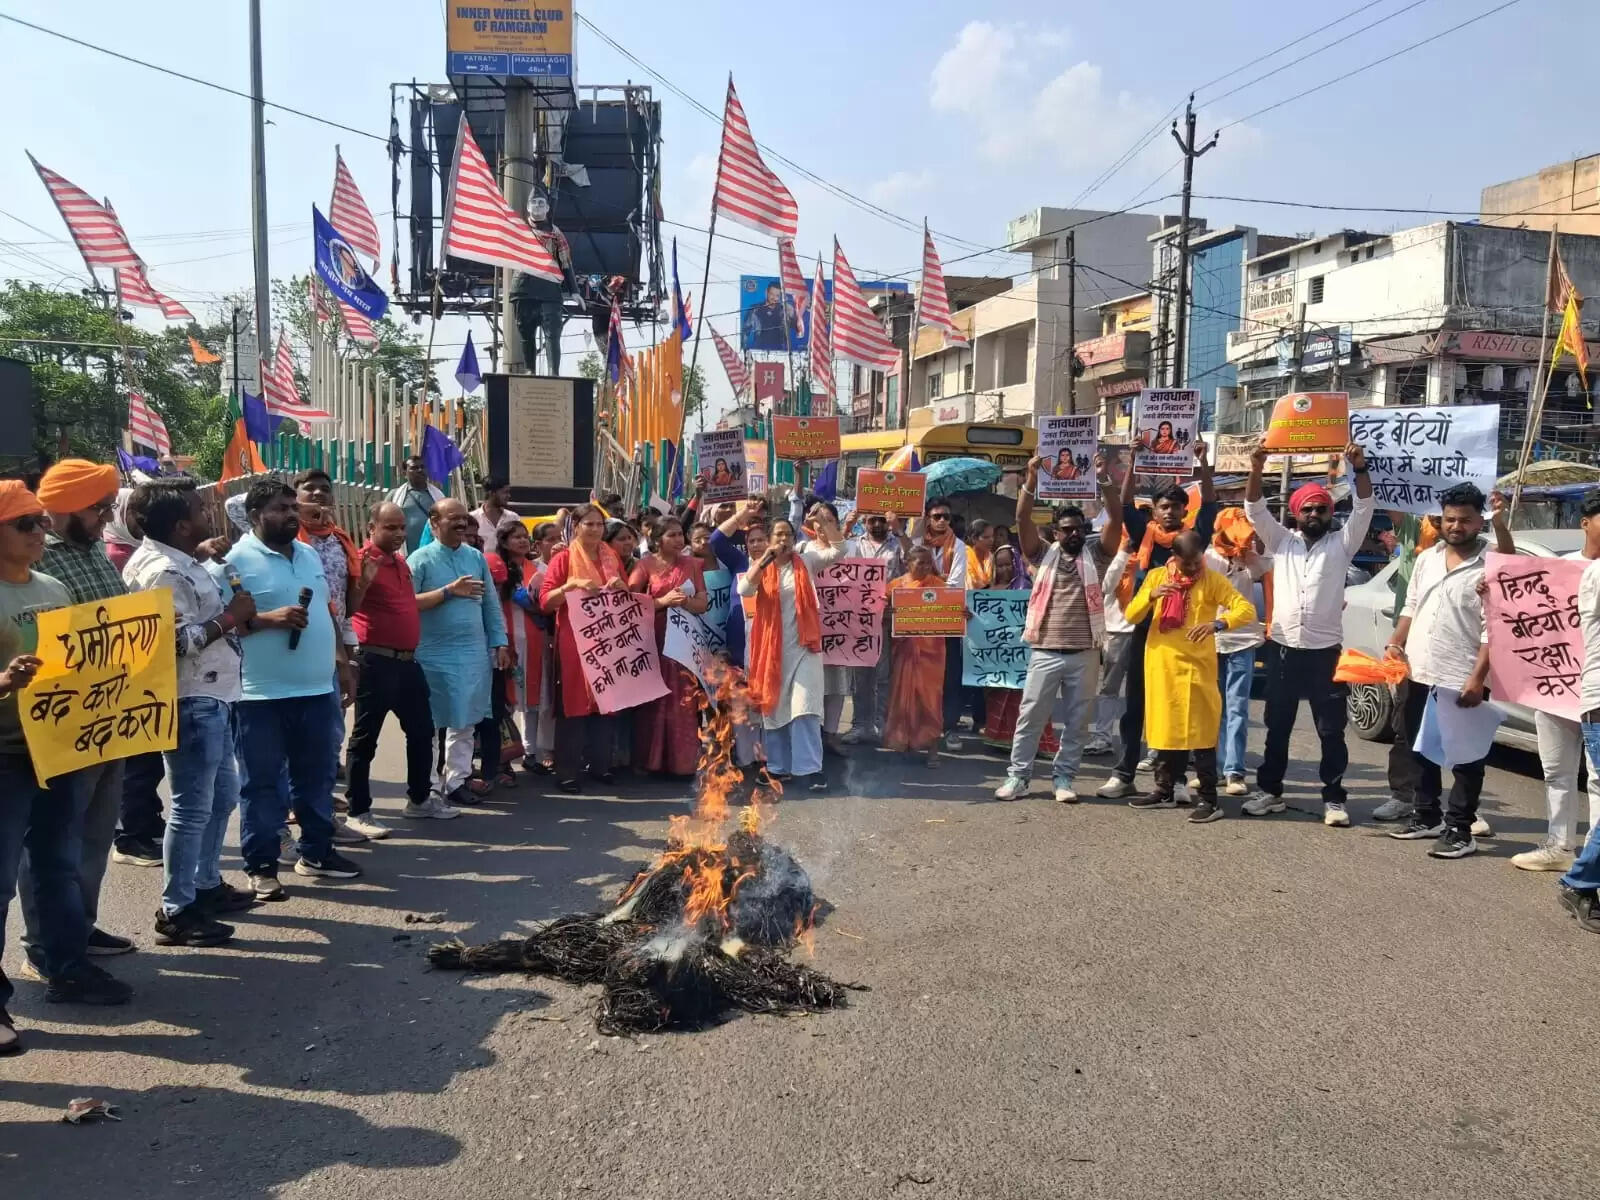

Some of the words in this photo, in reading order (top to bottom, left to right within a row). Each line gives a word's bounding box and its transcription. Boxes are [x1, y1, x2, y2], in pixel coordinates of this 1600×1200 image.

[456, 7, 490, 19] INNER
[493, 9, 530, 20] WHEEL
[533, 10, 563, 21] CLUB
[474, 21, 488, 32] OF
[1270, 287, 1293, 307] SPORTS
[1149, 391, 1195, 402] सावधान!
[1048, 417, 1092, 430] सावधान!
[1391, 412, 1453, 447] बेटियों
[1396, 449, 1416, 473] में
[1413, 484, 1433, 503] का
[863, 564, 886, 582] का
[822, 606, 854, 632] देश
[973, 592, 1007, 622] हिंदू
[579, 610, 616, 640] काली
[1501, 603, 1565, 639] बेटियों
[614, 622, 643, 649] वाली
[984, 625, 1015, 644] एक
[592, 665, 616, 695] कभी
[612, 656, 630, 677] ना
[629, 647, 653, 678] बनो
[30, 683, 80, 726] बंद
[75, 713, 117, 758] बंद
